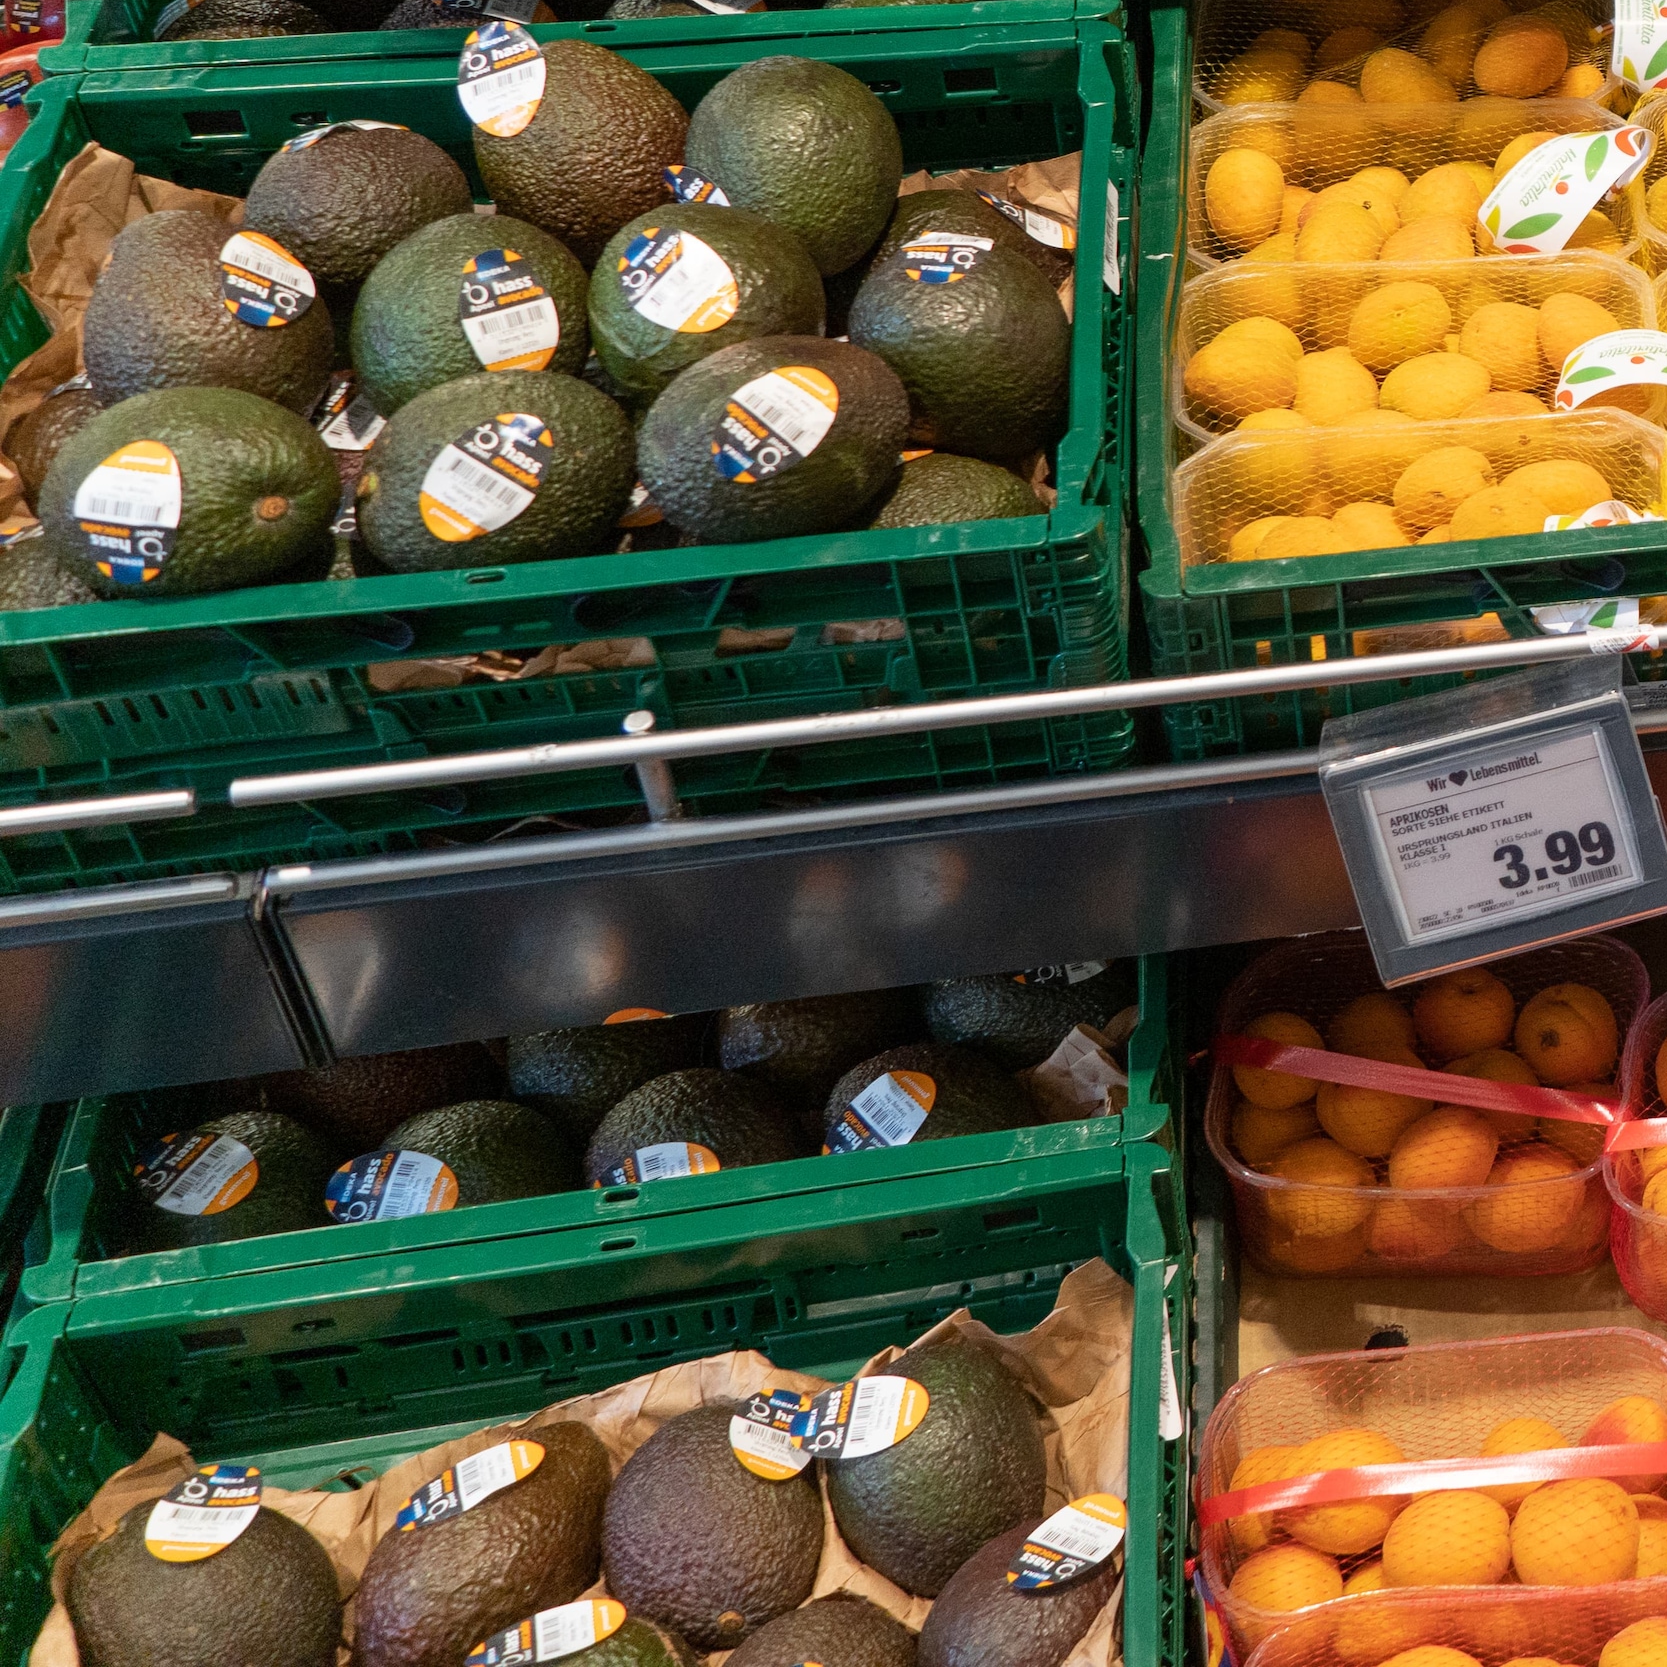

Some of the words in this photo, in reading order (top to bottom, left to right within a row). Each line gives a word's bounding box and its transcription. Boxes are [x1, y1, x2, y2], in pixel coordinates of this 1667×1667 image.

[492, 40, 528, 62] hass
[228, 275, 268, 299] hass
[492, 276, 533, 295] hass
[89, 534, 132, 555] hass
[1426, 778, 1447, 795] Wir
[1390, 804, 1449, 829] APRIKOSEN
[1391, 818, 1430, 837] SORTE
[1431, 811, 1464, 829] SIEHE
[1466, 800, 1505, 822] ETIKETT
[1397, 824, 1486, 855] URSPRUNGSLAND
[1488, 811, 1533, 833] ITALIEN
[1399, 845, 1436, 863] KLASSE
[1493, 820, 1617, 890] 3.99
[164, 1135, 203, 1168] hass
[362, 1157, 382, 1196] hass
[371, 1152, 395, 1196] avocado
[824, 1389, 843, 1427] hass
[215, 1485, 258, 1499] hass
[1019, 1552, 1052, 1573] hass
